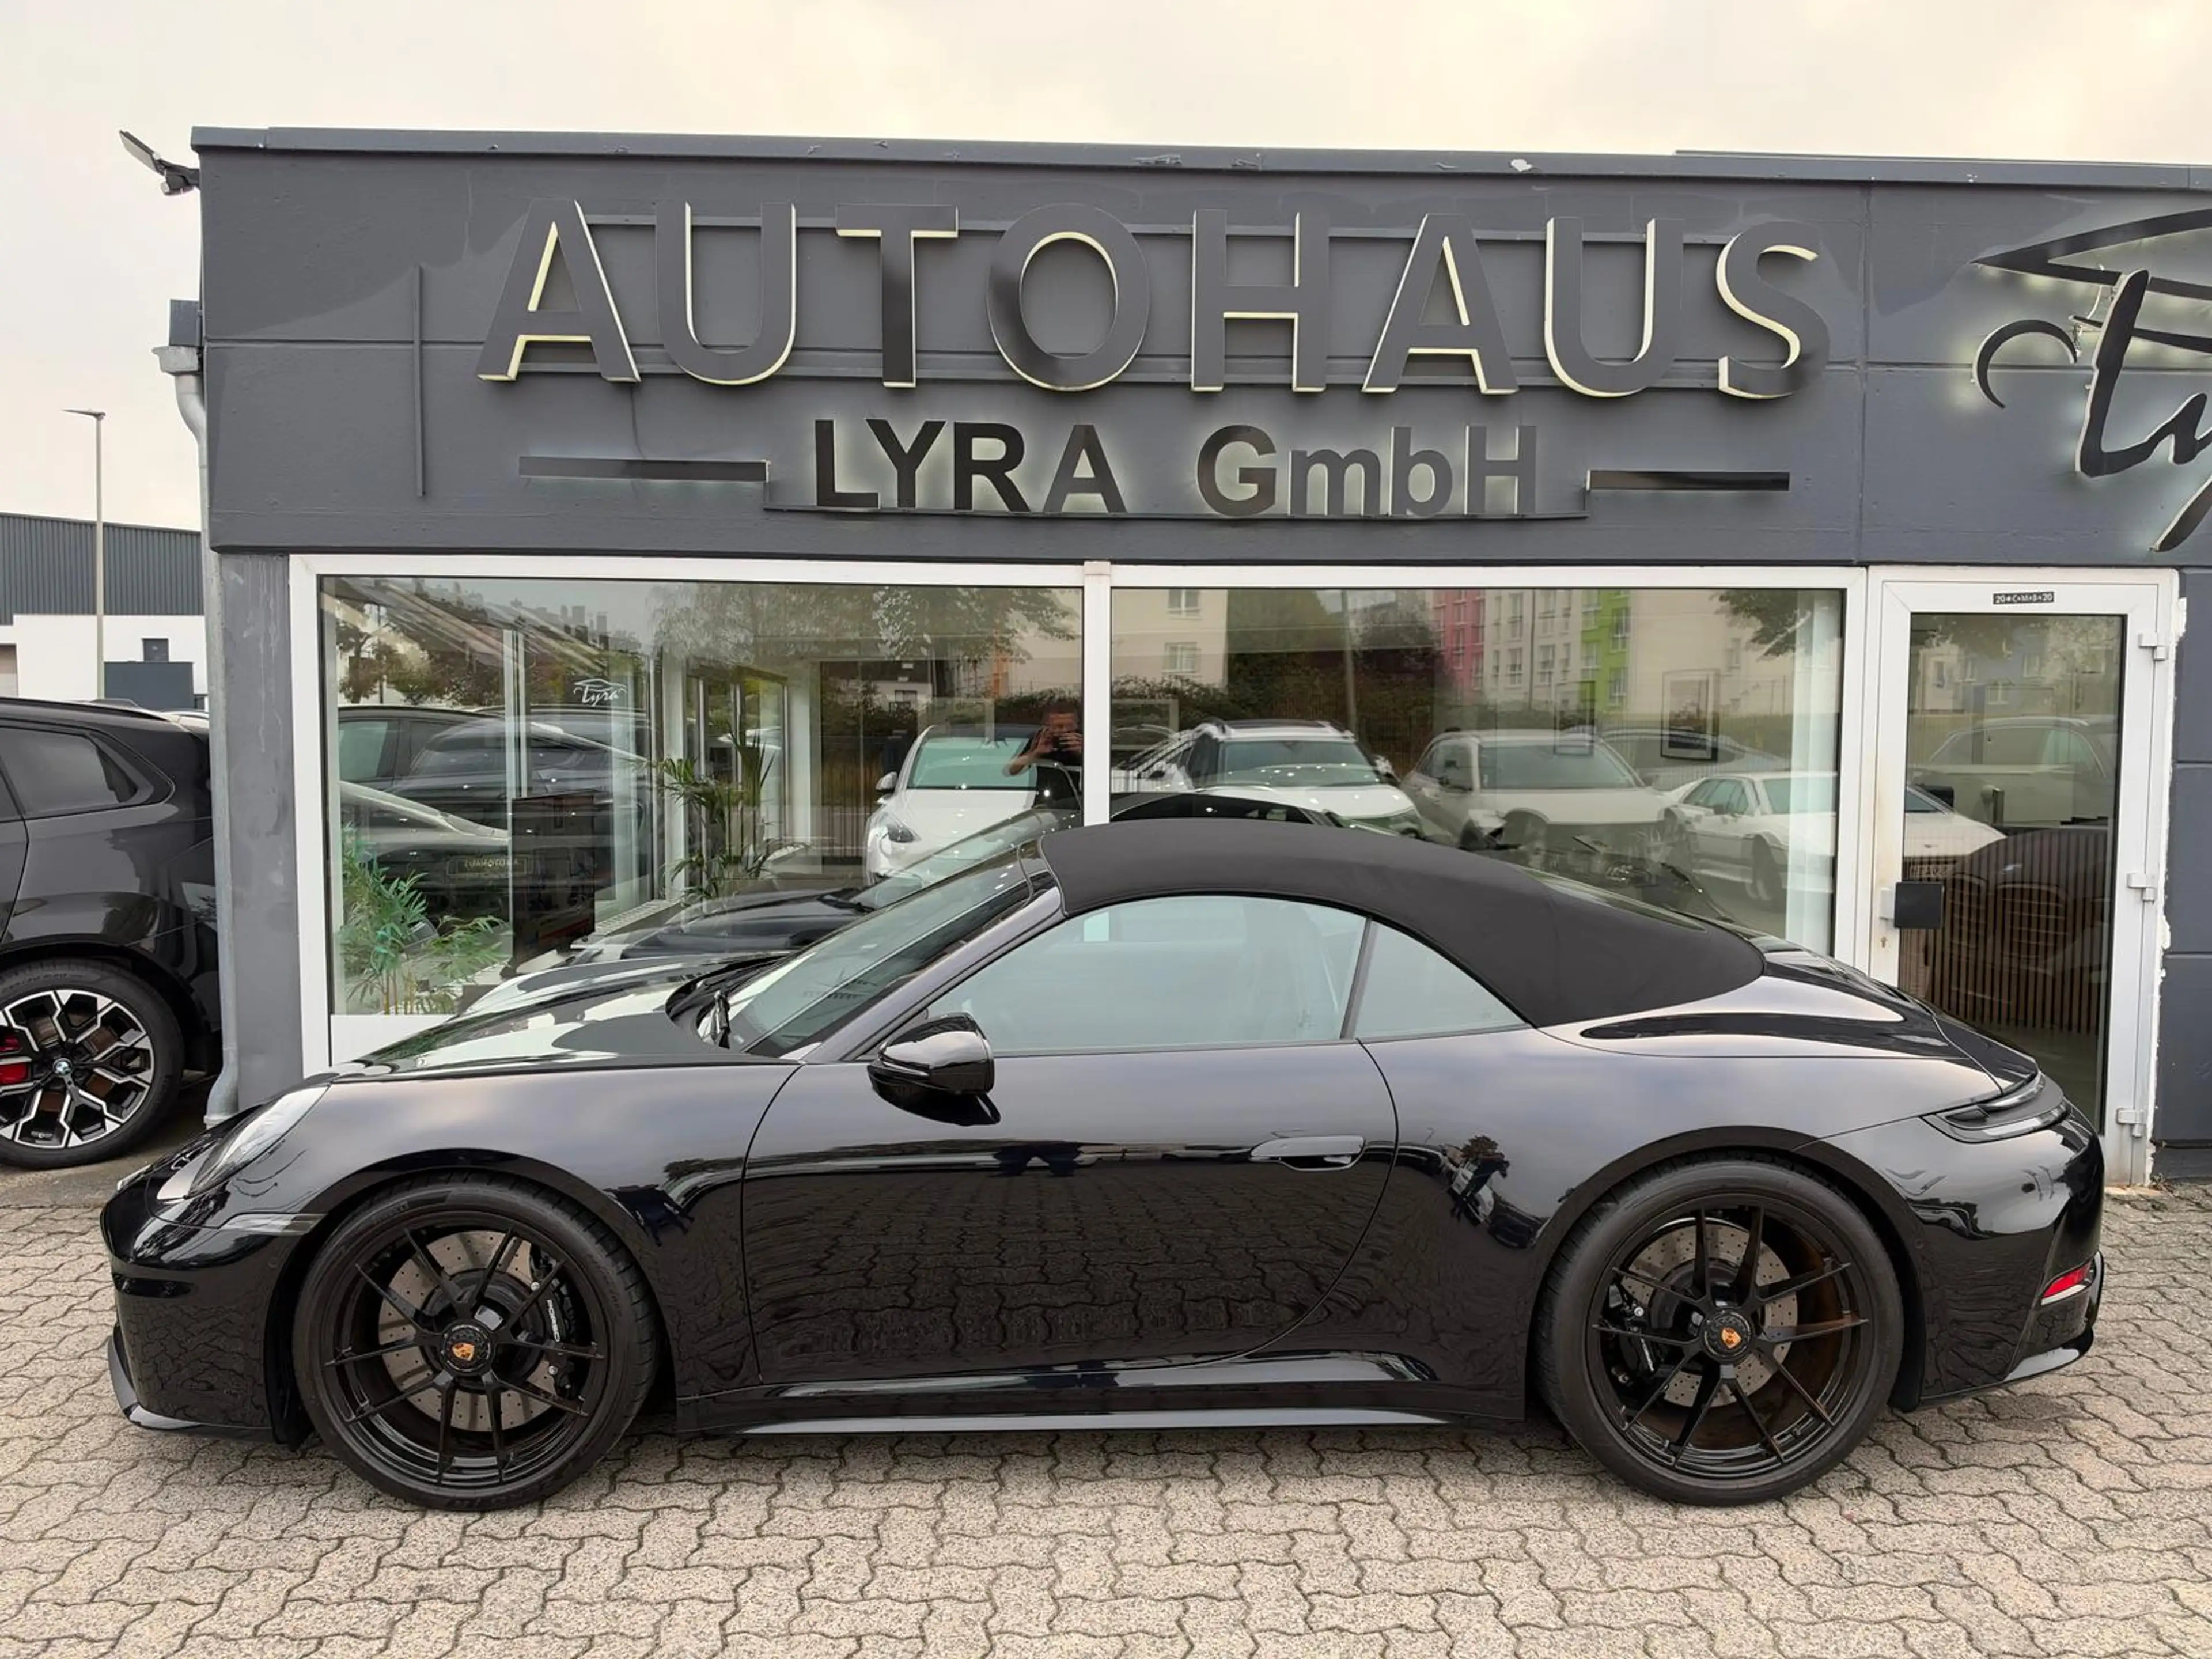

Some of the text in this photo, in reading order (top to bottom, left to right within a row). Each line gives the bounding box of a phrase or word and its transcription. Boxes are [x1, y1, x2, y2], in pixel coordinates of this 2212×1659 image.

[476, 198, 1830, 401] AUTOHAUS
[815, 419, 1536, 517] LYRA GmbH
